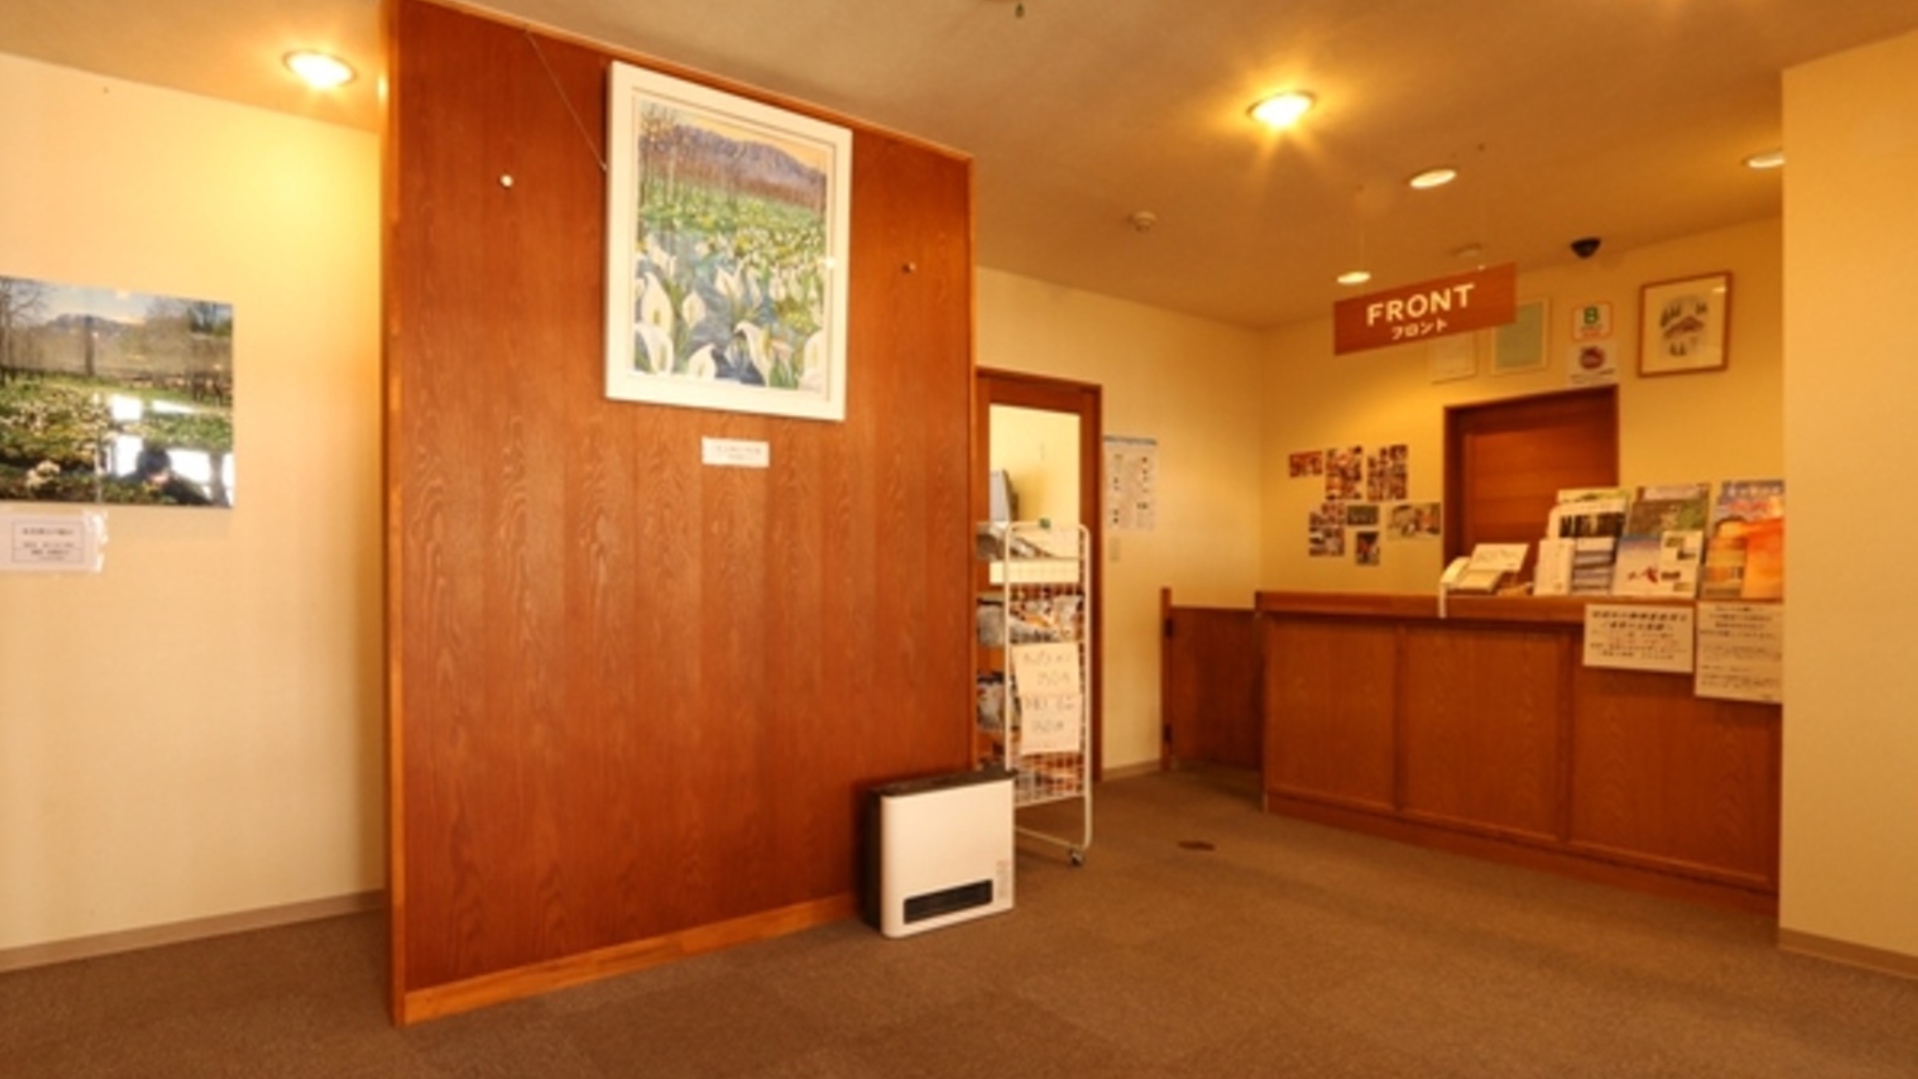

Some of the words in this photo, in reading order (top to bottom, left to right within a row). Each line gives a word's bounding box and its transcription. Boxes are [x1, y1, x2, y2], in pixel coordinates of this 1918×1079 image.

[1367, 283, 1474, 326] FRONT
[1391, 318, 1447, 340] フロント
